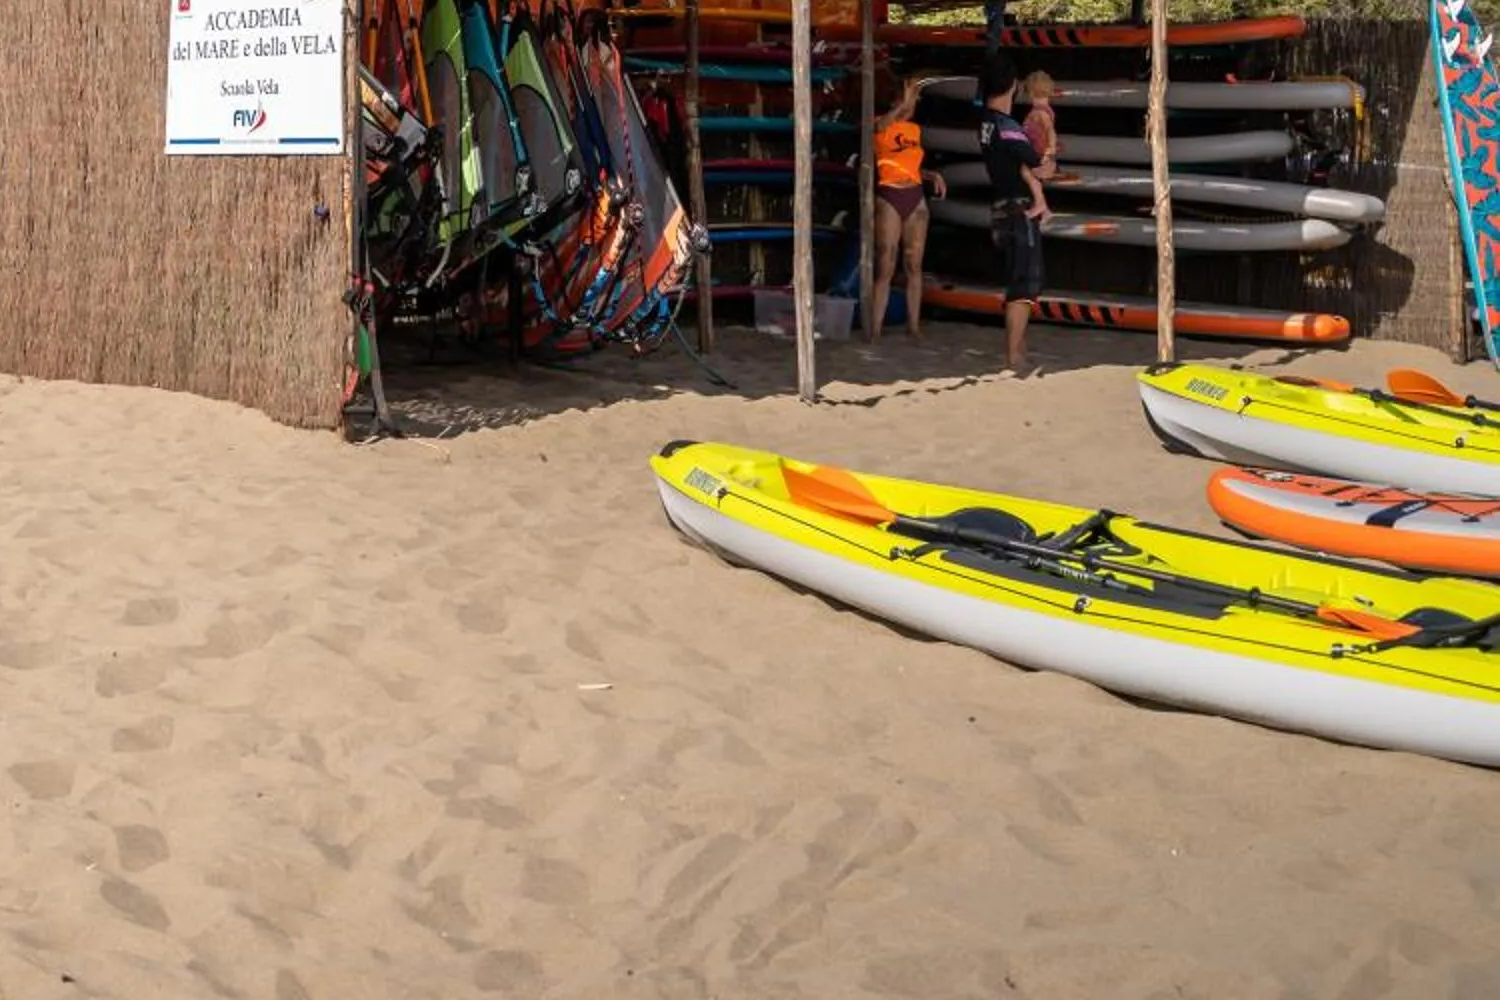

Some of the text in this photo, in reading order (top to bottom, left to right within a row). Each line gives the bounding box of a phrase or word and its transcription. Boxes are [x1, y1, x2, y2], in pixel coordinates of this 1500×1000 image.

[205, 7, 302, 31] ACCADEMIA
[173, 34, 337, 61] del MARE e della VELA
[220, 78, 279, 96] Scuola Vela
